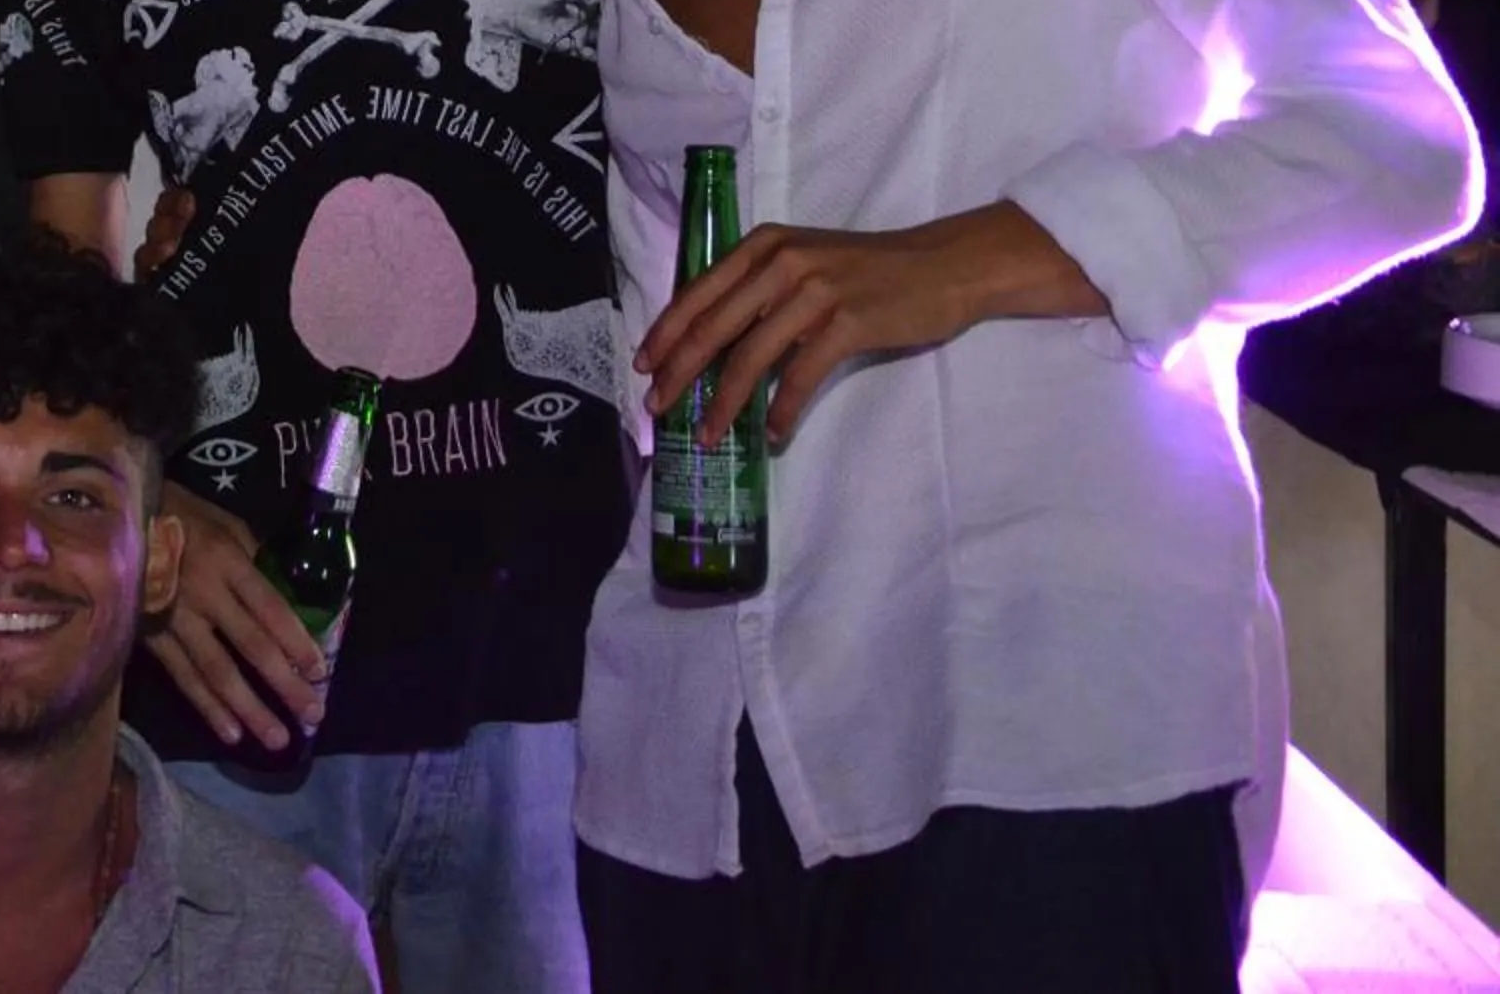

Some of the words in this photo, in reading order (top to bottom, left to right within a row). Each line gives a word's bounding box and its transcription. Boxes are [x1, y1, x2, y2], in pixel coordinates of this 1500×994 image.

[156, 248, 208, 300] THIS
[200, 224, 226, 254] IS
[216, 184, 258, 228] THE
[240, 133, 297, 192] LAST
[288, 93, 356, 149] TIME
[385, 397, 508, 477] BRAIN
